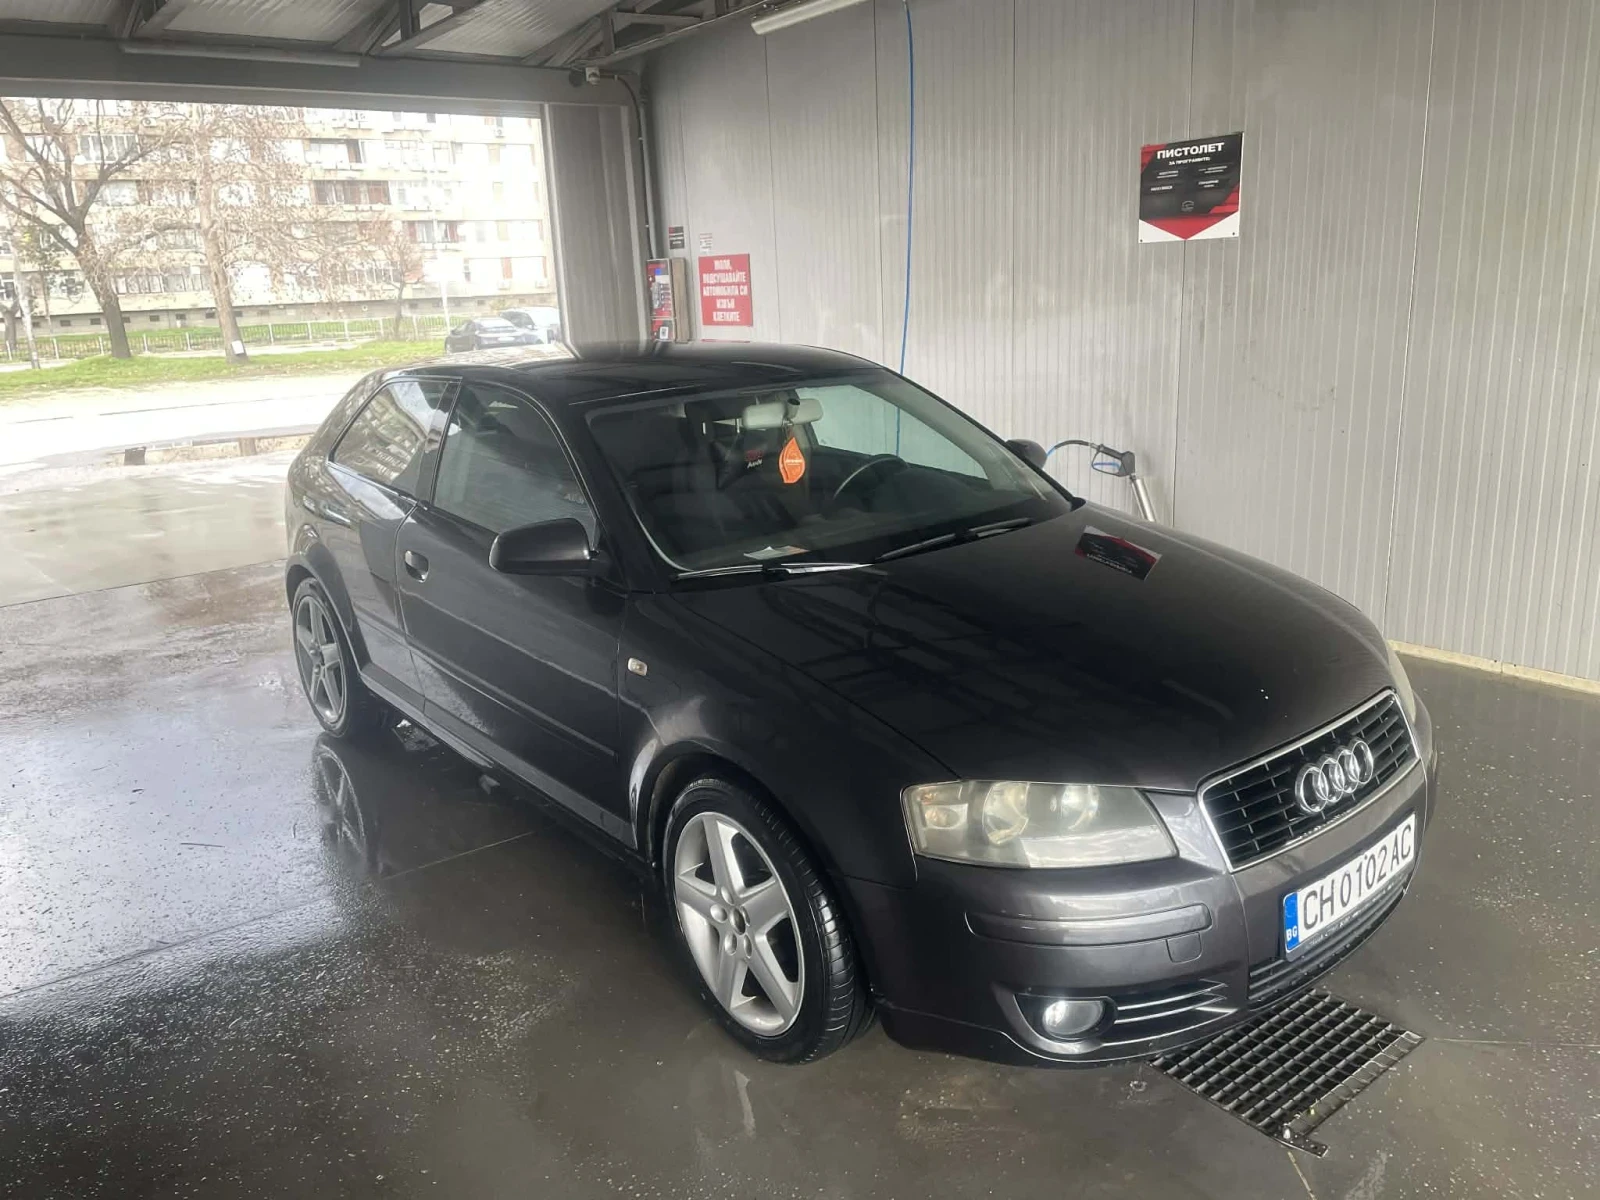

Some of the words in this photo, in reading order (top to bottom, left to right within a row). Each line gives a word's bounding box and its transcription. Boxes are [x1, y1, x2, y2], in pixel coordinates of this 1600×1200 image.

[1156, 142, 1225, 160] ПИСТОЛЕТ
[1303, 879, 1335, 930] CH
[1339, 845, 1388, 908] 0102
[1390, 823, 1412, 871] AC
[1285, 925, 1298, 942] BG
